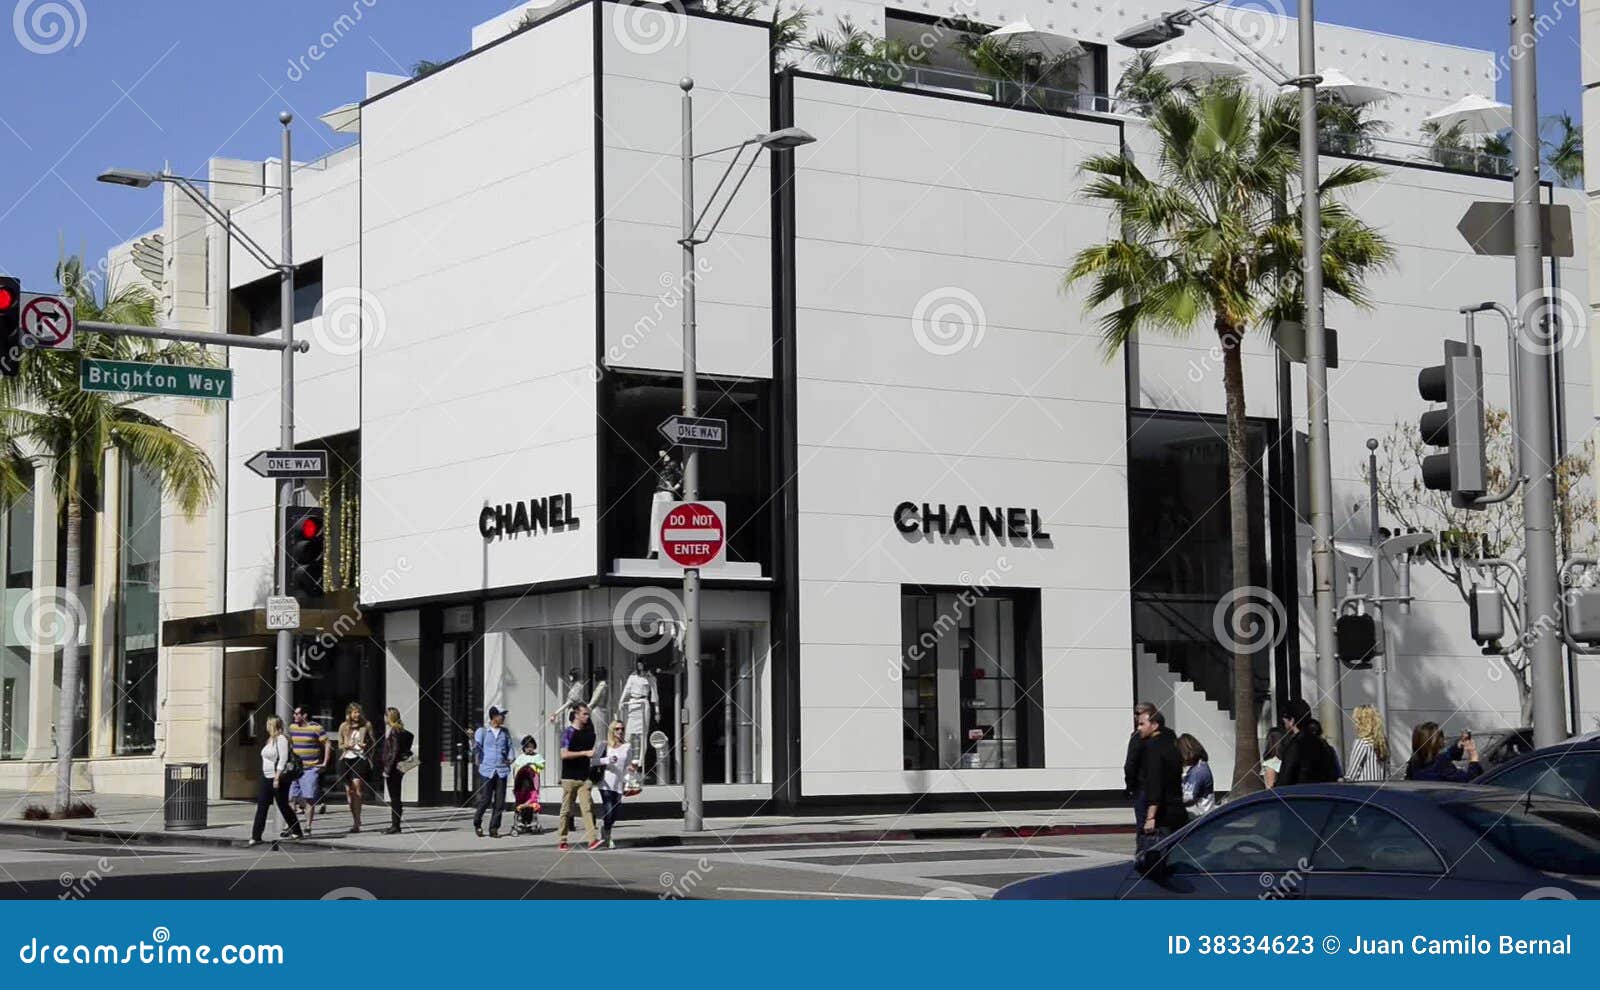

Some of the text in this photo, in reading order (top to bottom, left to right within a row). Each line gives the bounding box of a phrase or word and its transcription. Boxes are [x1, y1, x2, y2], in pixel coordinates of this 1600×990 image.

[88, 367, 226, 395] Brighton Way
[676, 425, 719, 439] ONE WAY
[268, 459, 317, 469] ONE WAY
[479, 492, 580, 539] CHANEL
[669, 514, 714, 526] DO NOT
[893, 501, 1052, 542] CHANEL
[674, 543, 710, 555] ENTER
[269, 614, 282, 625] OK
